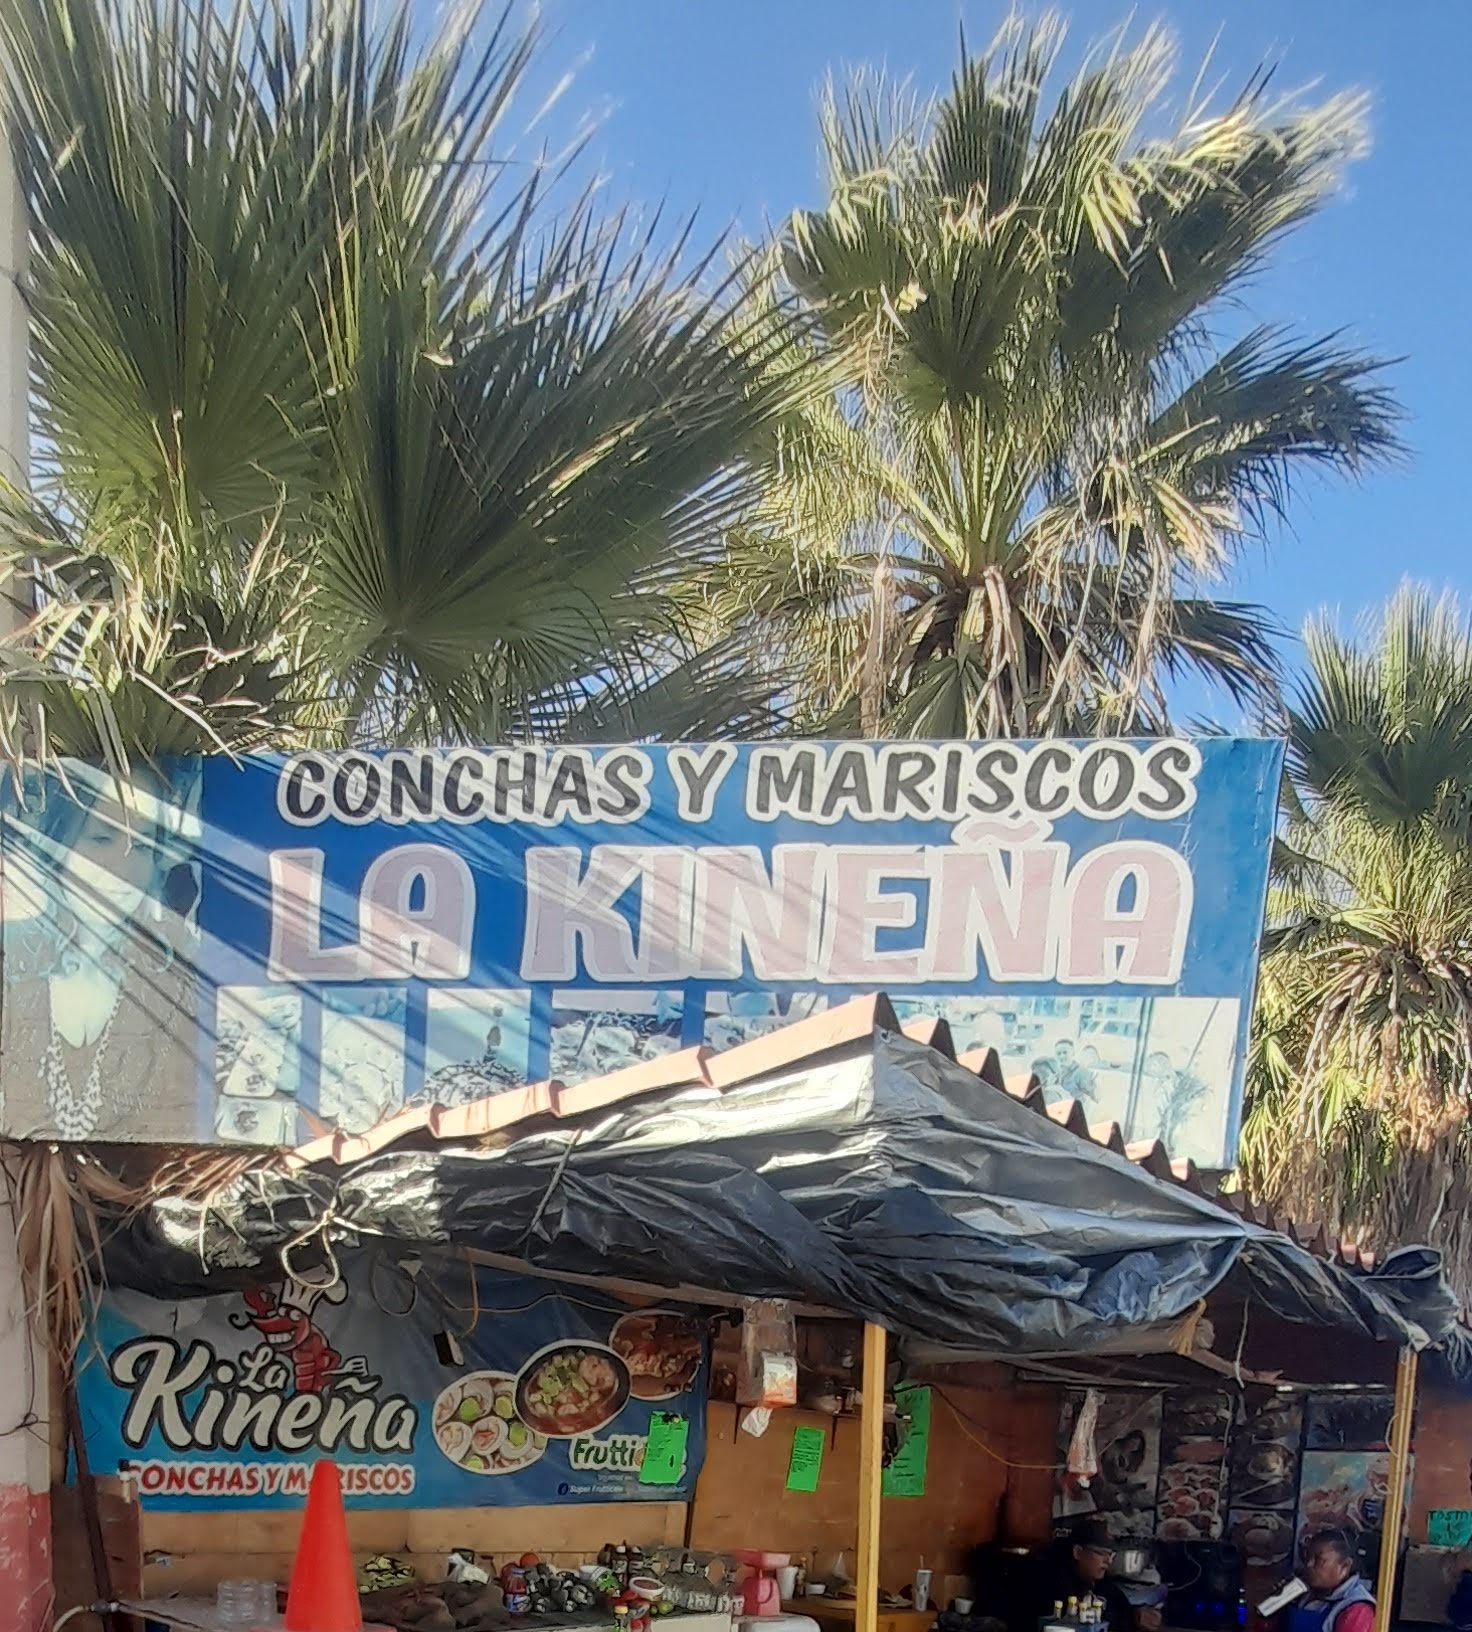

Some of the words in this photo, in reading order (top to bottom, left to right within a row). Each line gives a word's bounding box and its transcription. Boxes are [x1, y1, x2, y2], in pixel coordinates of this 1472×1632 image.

[280, 746, 651, 823] CONCHAS
[669, 746, 736, 822] Y
[750, 743, 1199, 821] MARISCOS
[268, 843, 477, 981] LA
[520, 816, 1193, 982] KINEÑA
[111, 1337, 418, 1450] Kineña
[240, 1346, 290, 1391] La
[264, 1465, 279, 1490] Y
